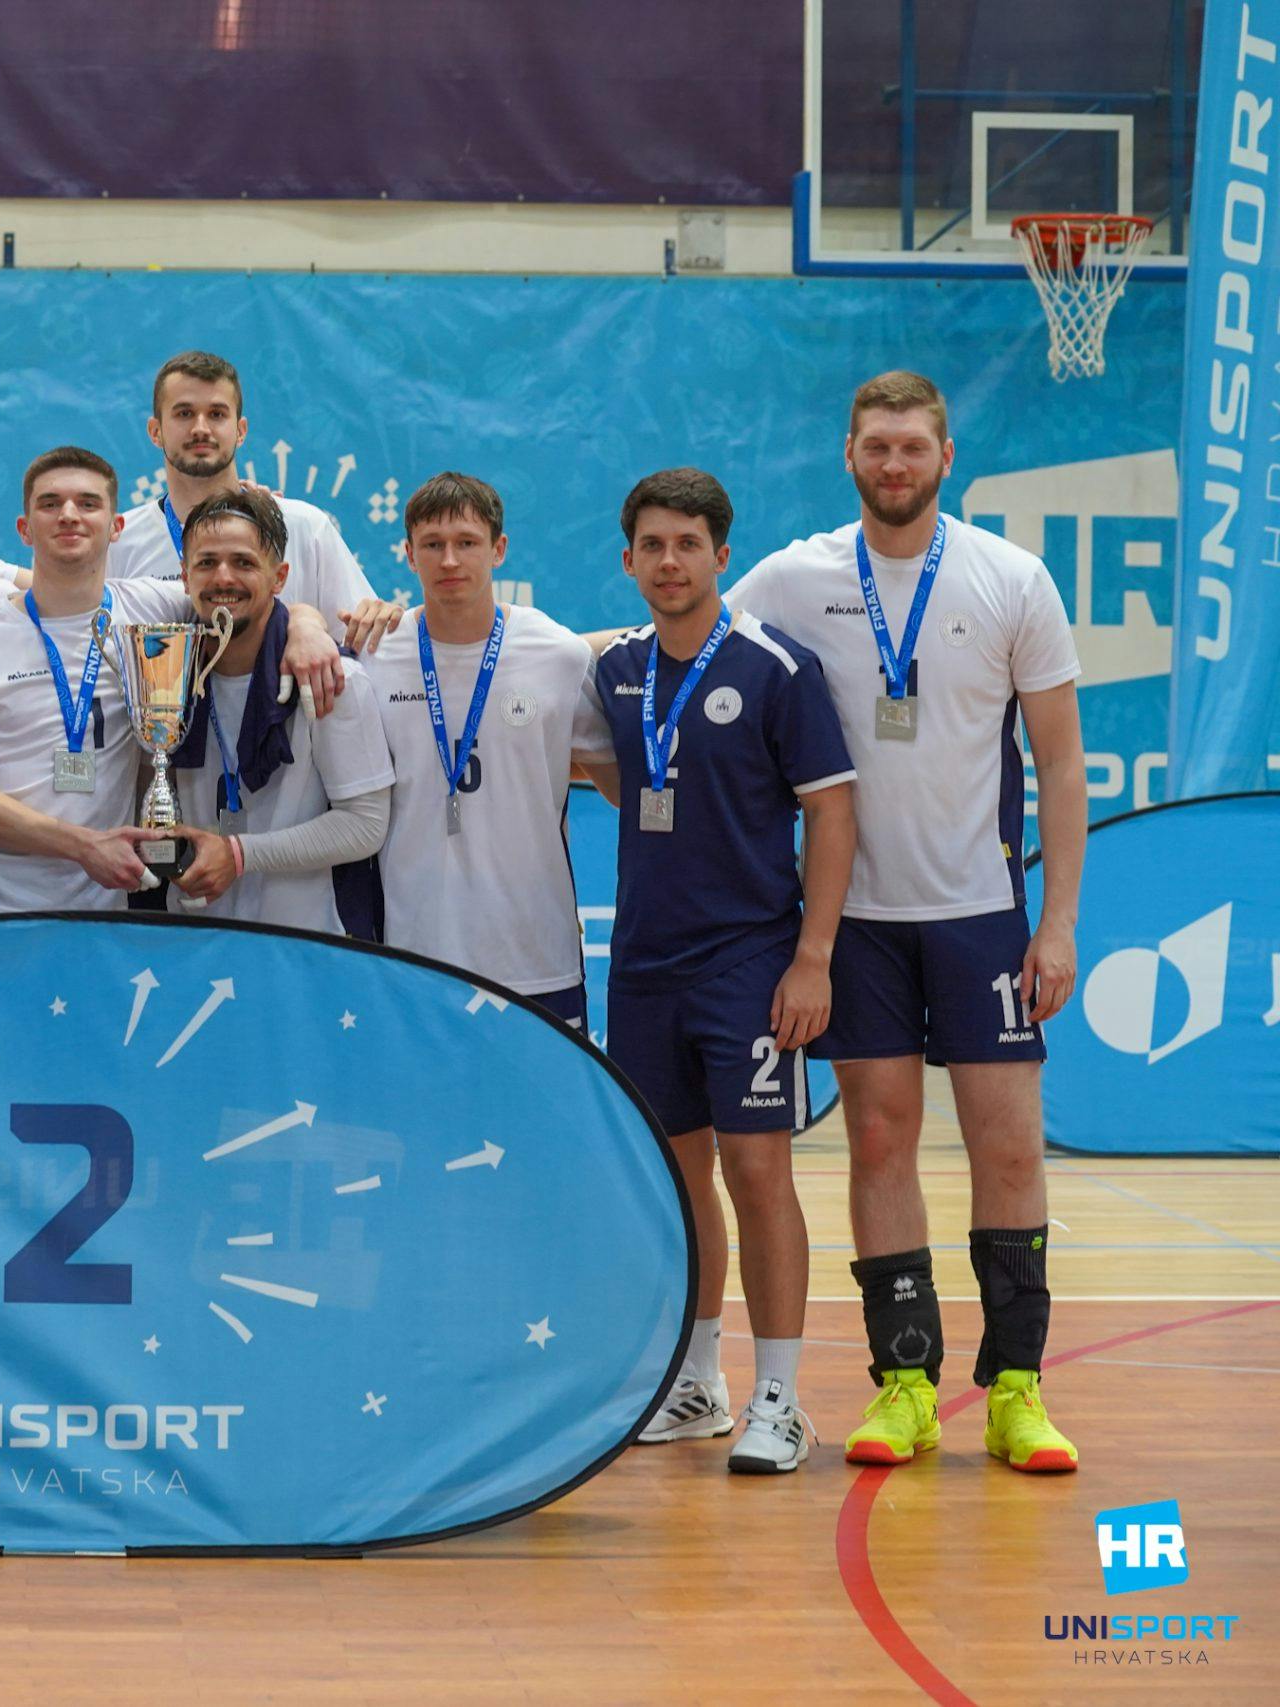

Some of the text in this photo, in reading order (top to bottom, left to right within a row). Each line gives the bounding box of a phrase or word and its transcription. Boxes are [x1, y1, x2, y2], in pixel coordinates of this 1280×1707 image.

[1195, 3, 1276, 661] UNISPORT
[924, 523, 946, 574] FINALS
[862, 576, 886, 631] FINALS
[84, 642, 100, 685] FINA
[482, 617, 504, 671] FINALS
[694, 620, 728, 671] FINALS
[425, 670, 443, 725] FINALS
[643, 670, 656, 721] FINALS
[751, 1036, 780, 1092] 2
[4, 1102, 134, 1305] 2
